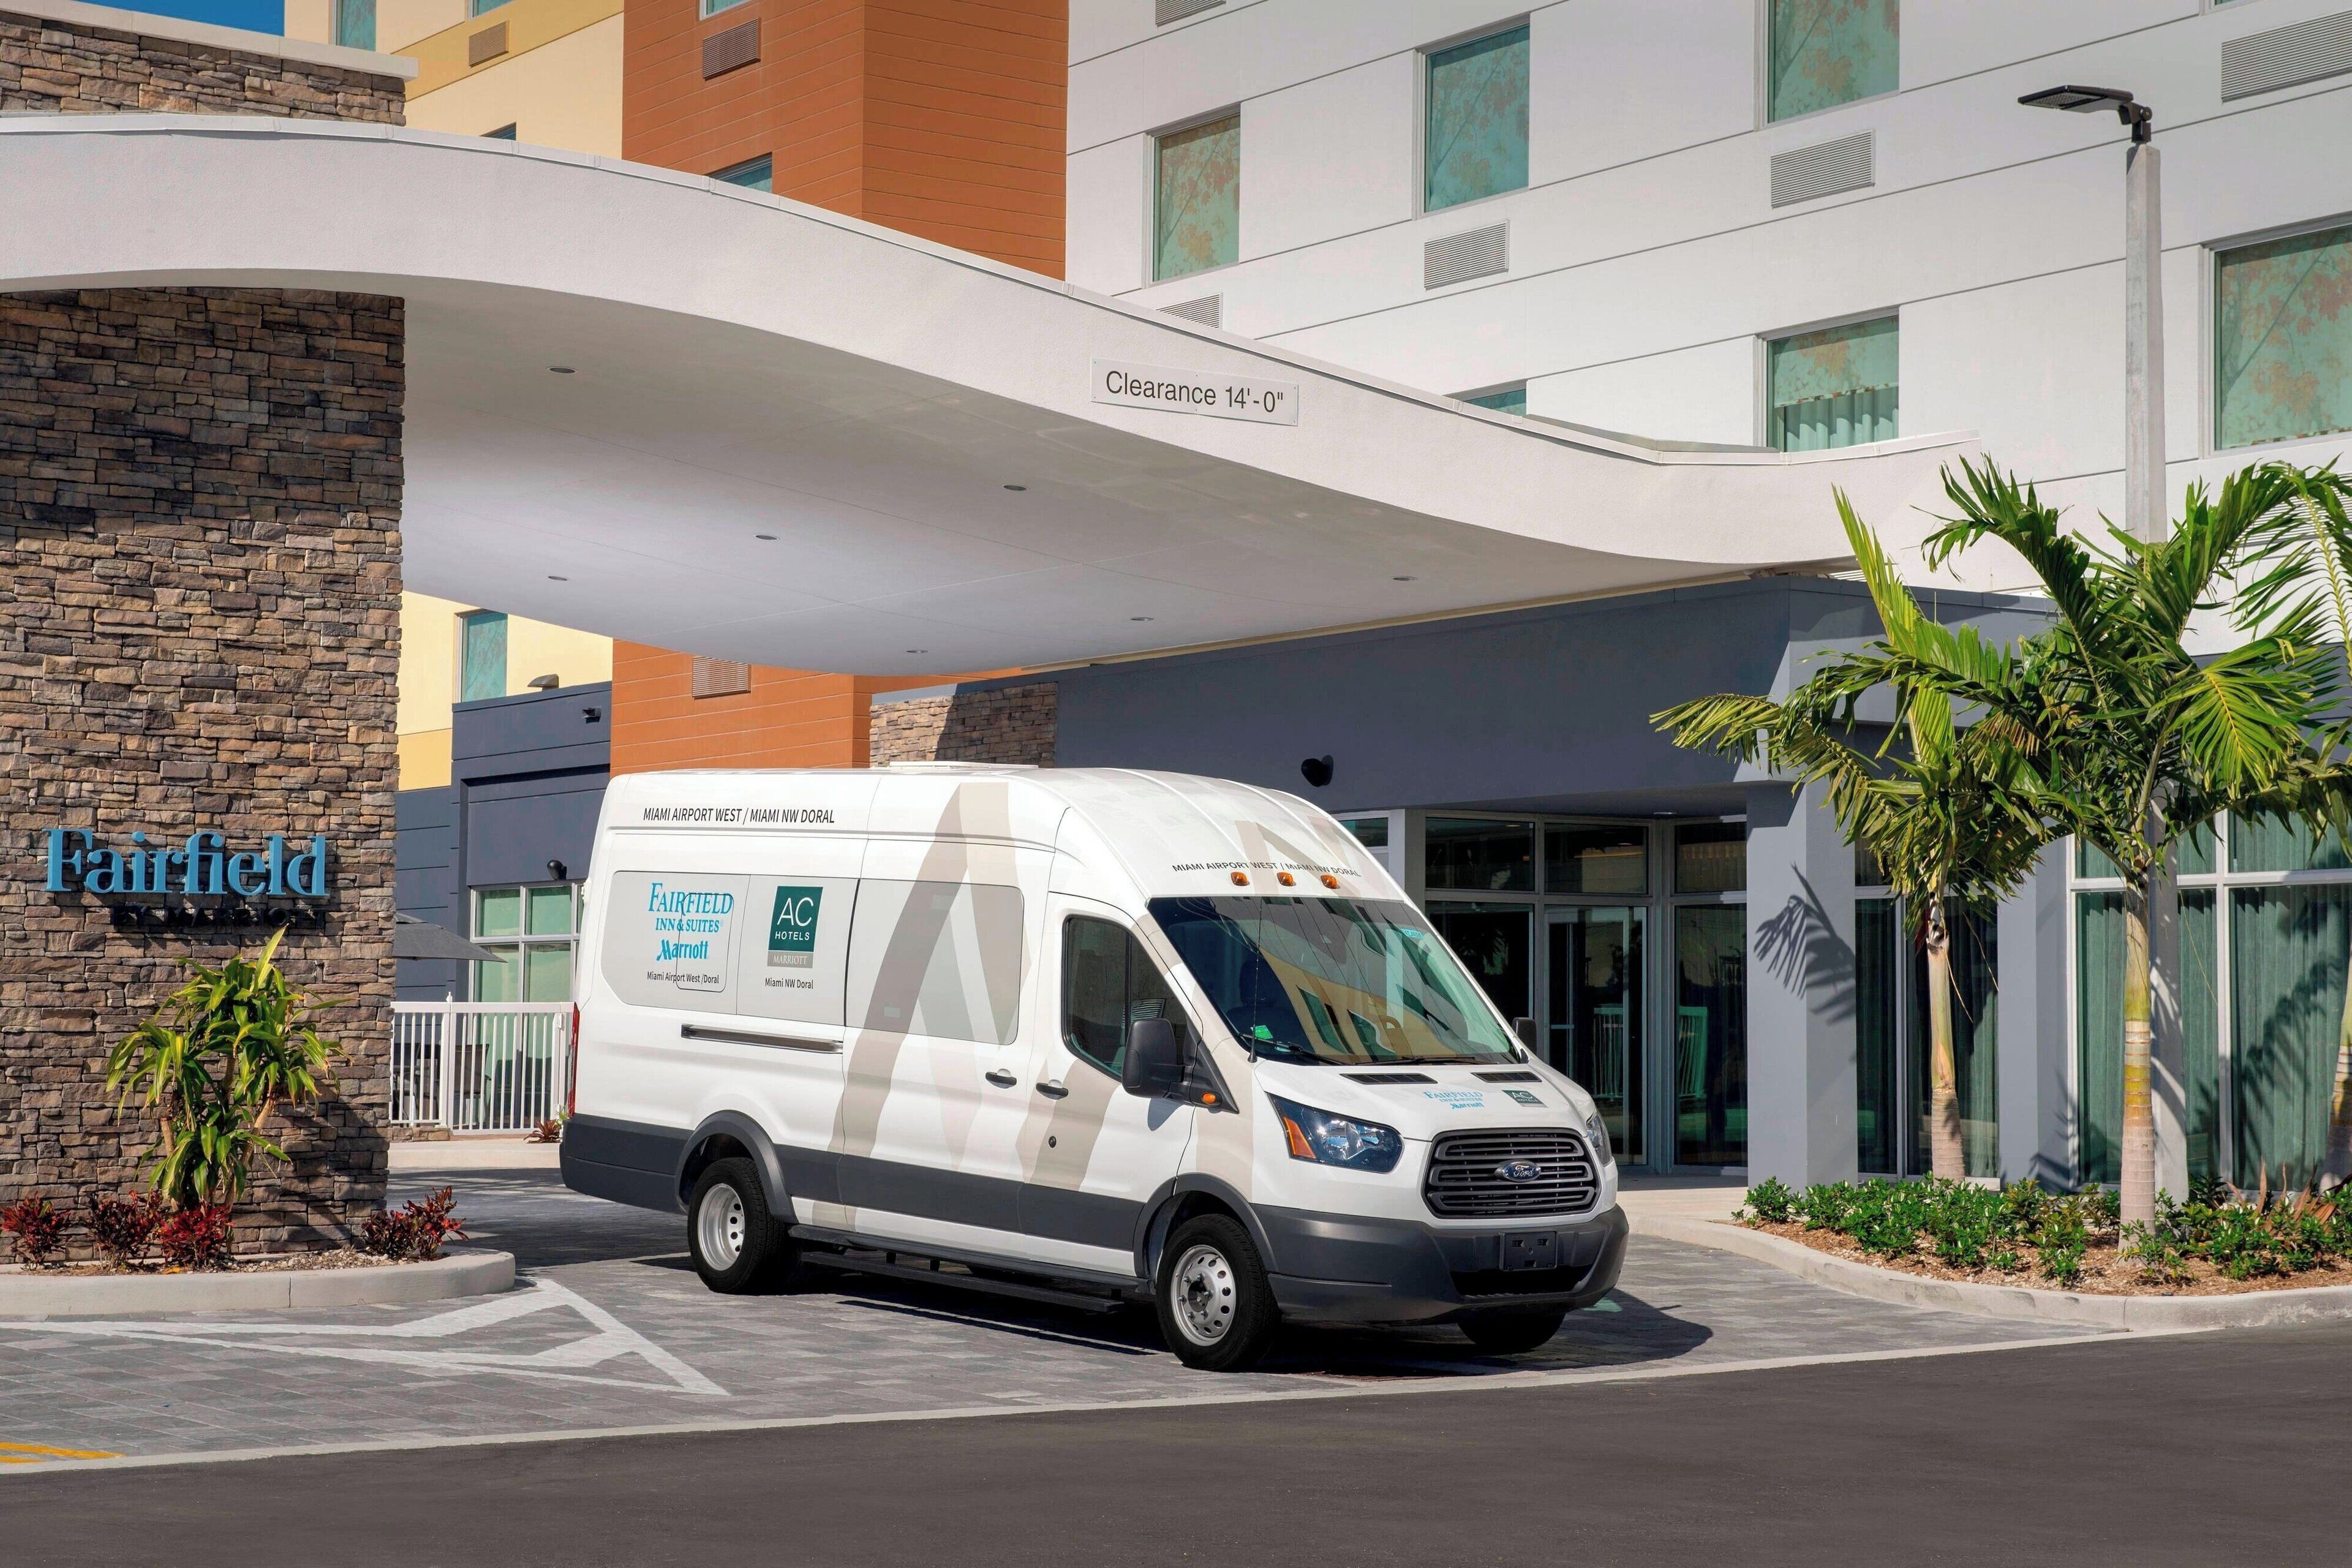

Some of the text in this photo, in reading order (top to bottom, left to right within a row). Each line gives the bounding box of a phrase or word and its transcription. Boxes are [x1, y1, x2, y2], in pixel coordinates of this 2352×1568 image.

[1106, 371, 1216, 405] Clearance
[643, 807, 835, 825] MIAMI AIRPORT WEST / MIAMI NW DORAL
[42, 828, 330, 896] Fairfield
[1172, 862, 1204, 872] MIAMI
[1287, 863, 1314, 872] MIAMI
[1315, 865, 1330, 873] NW
[1331, 867, 1362, 876] DORAL
[649, 883, 733, 916] FAIRFIELD
[777, 897, 813, 927] AC
[655, 918, 720, 932] INN & SUITES
[775, 931, 810, 940] HOTELS
[656, 940, 708, 960] Marriott
[773, 955, 808, 965] MARRIOTT
[647, 971, 664, 981] Miami
[665, 972, 685, 984] Airport
[686, 973, 700, 982] West
[765, 978, 813, 989] Miami NW Doral
[1513, 1165, 1534, 1177] Ford
